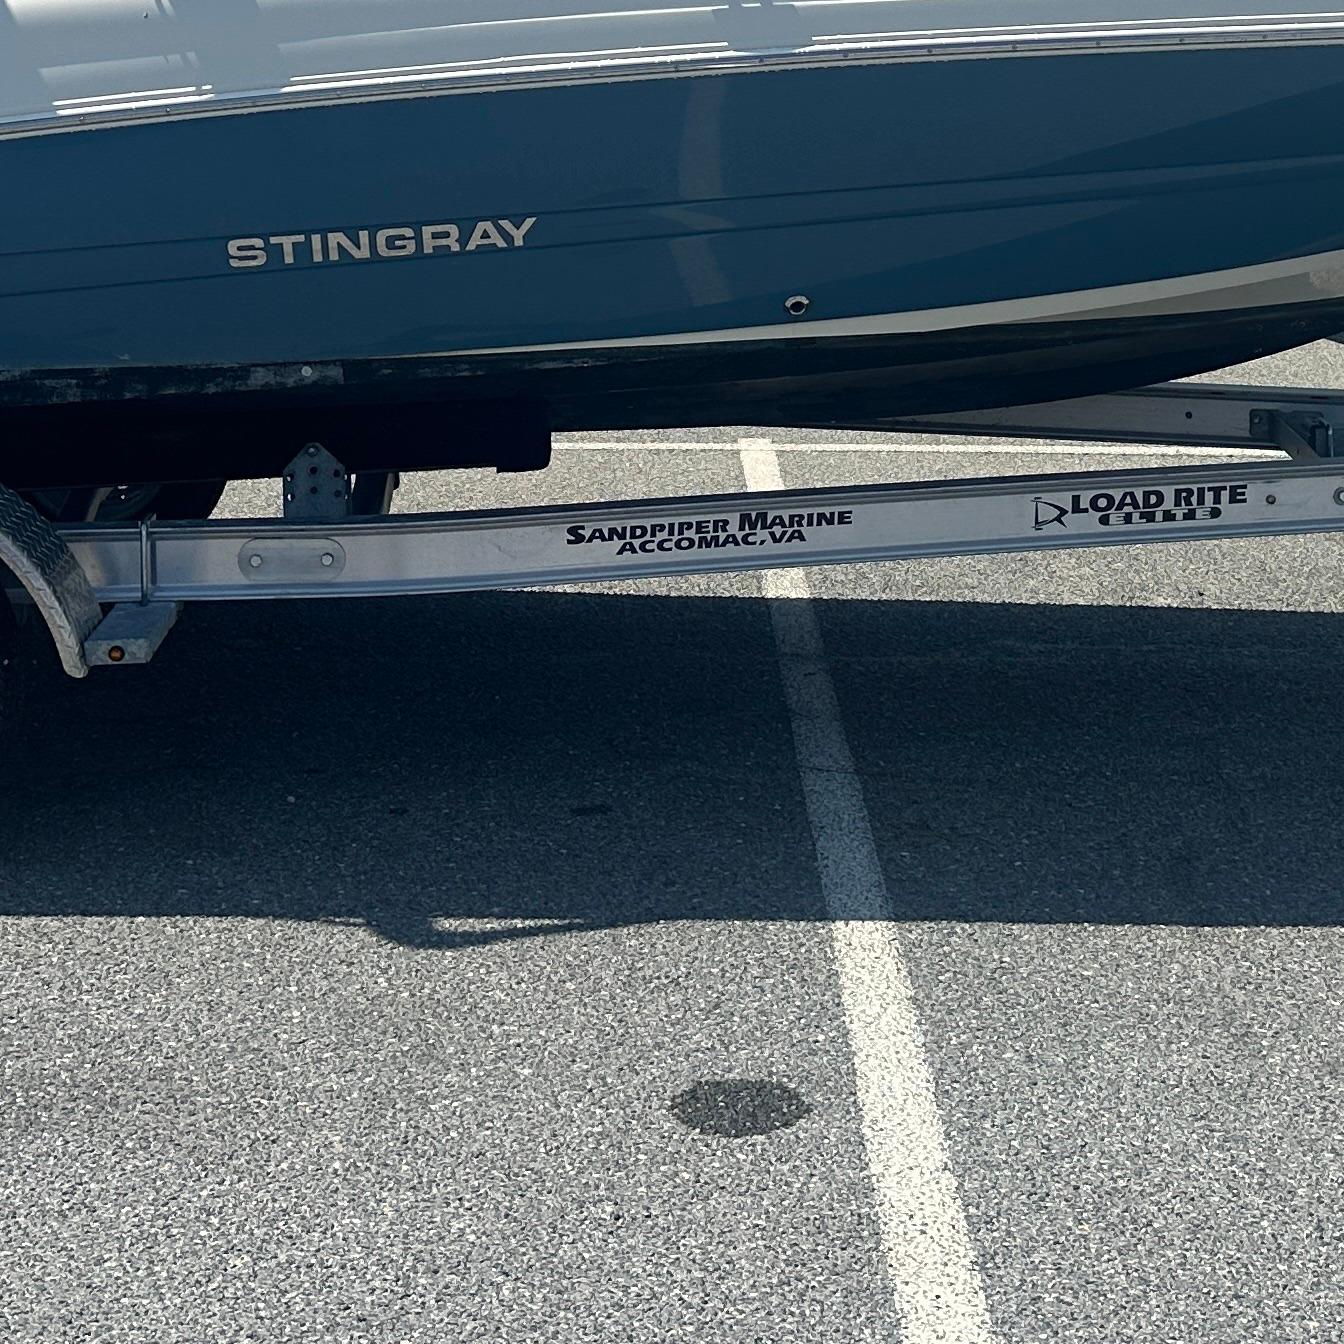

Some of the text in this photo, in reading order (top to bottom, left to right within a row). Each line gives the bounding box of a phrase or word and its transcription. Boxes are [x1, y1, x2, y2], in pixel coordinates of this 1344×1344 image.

[227, 217, 537, 268] STINGRAY
[1071, 484, 1248, 514] LOAD RITE
[566, 510, 853, 544] SANDPIPER MARINE
[1108, 507, 1213, 526] ELITE
